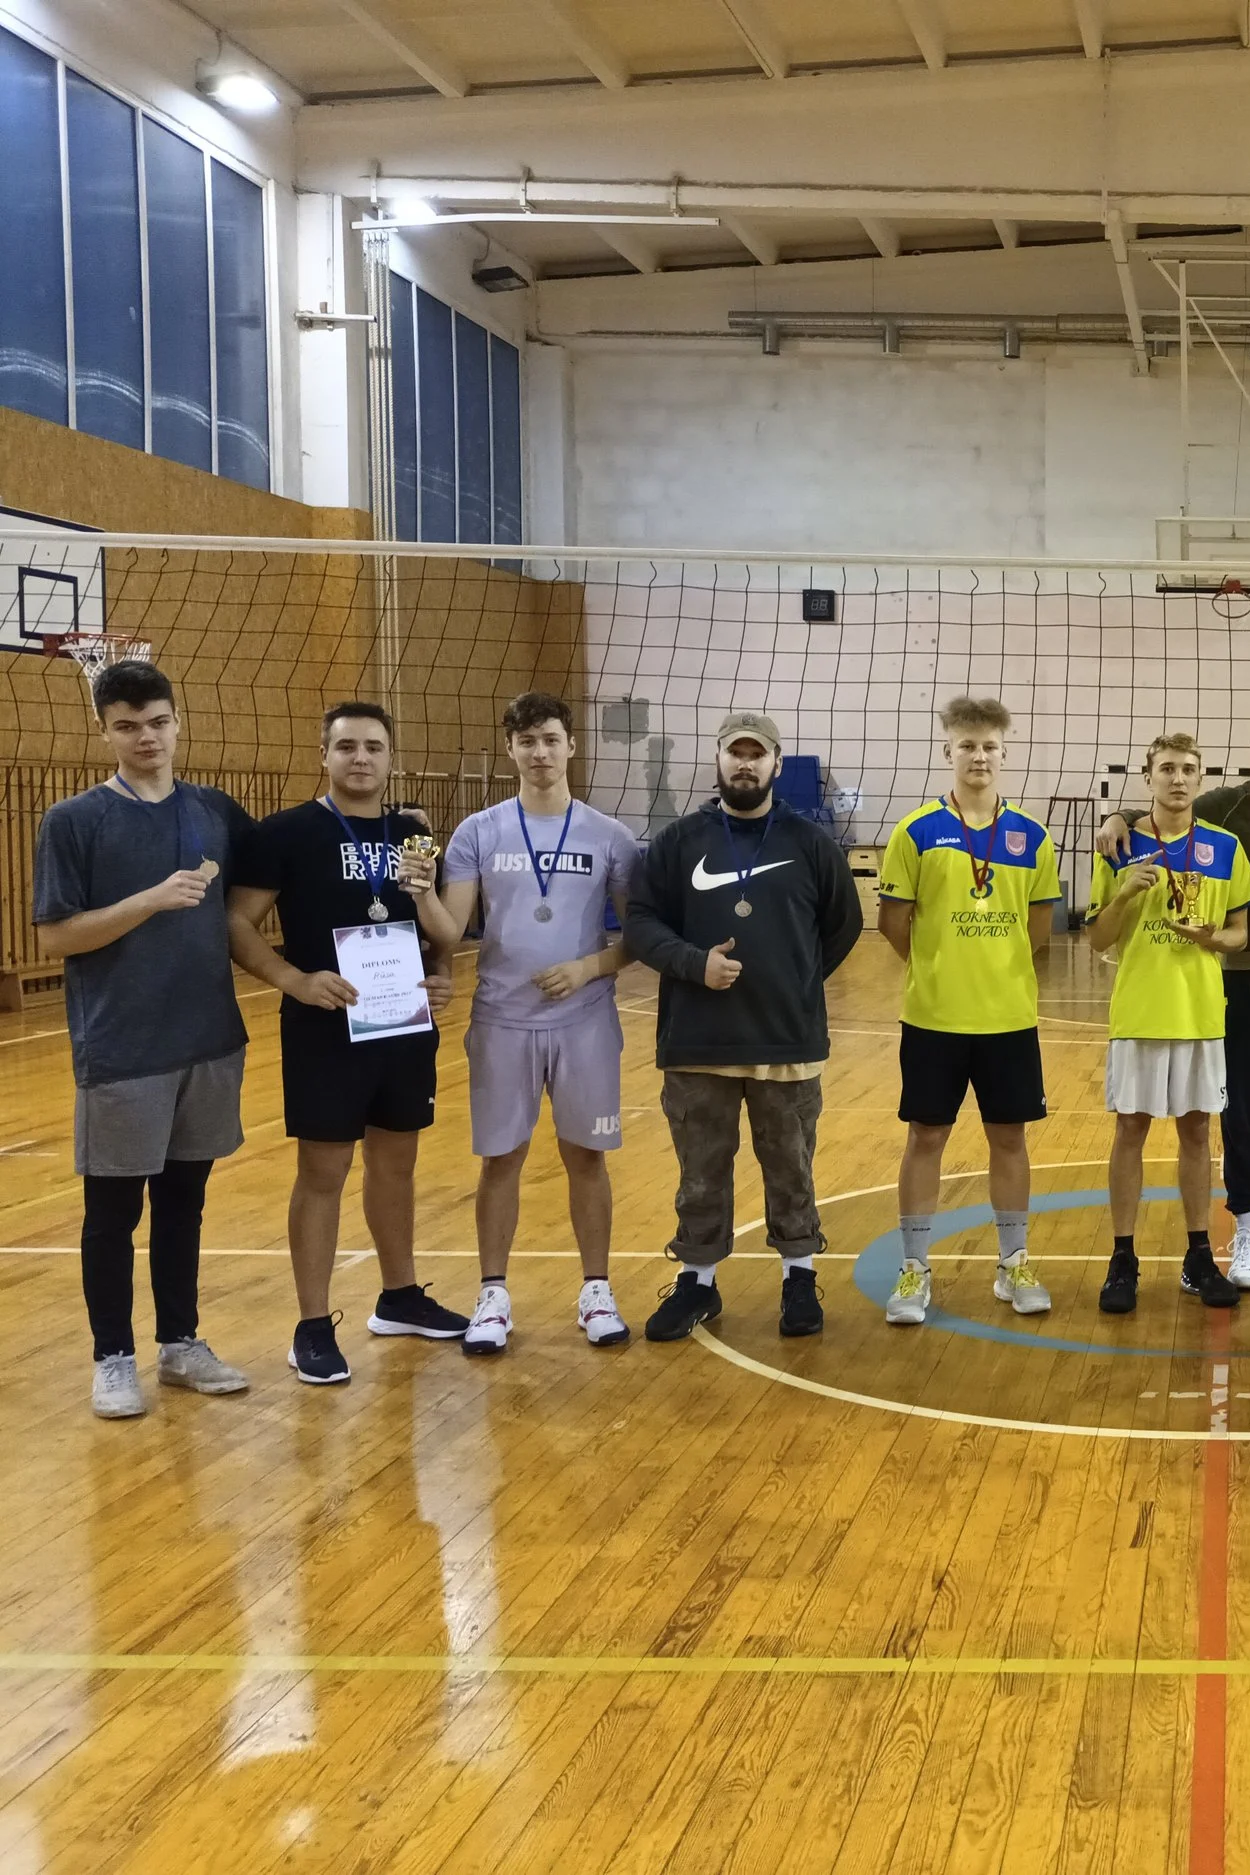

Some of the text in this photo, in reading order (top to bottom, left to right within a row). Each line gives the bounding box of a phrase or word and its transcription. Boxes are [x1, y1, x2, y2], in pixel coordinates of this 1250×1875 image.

[492, 853, 532, 872] JUST
[970, 868, 995, 899] 3
[956, 925, 1010, 937] NOVADS
[361, 958, 401, 969] DIPLOMS
